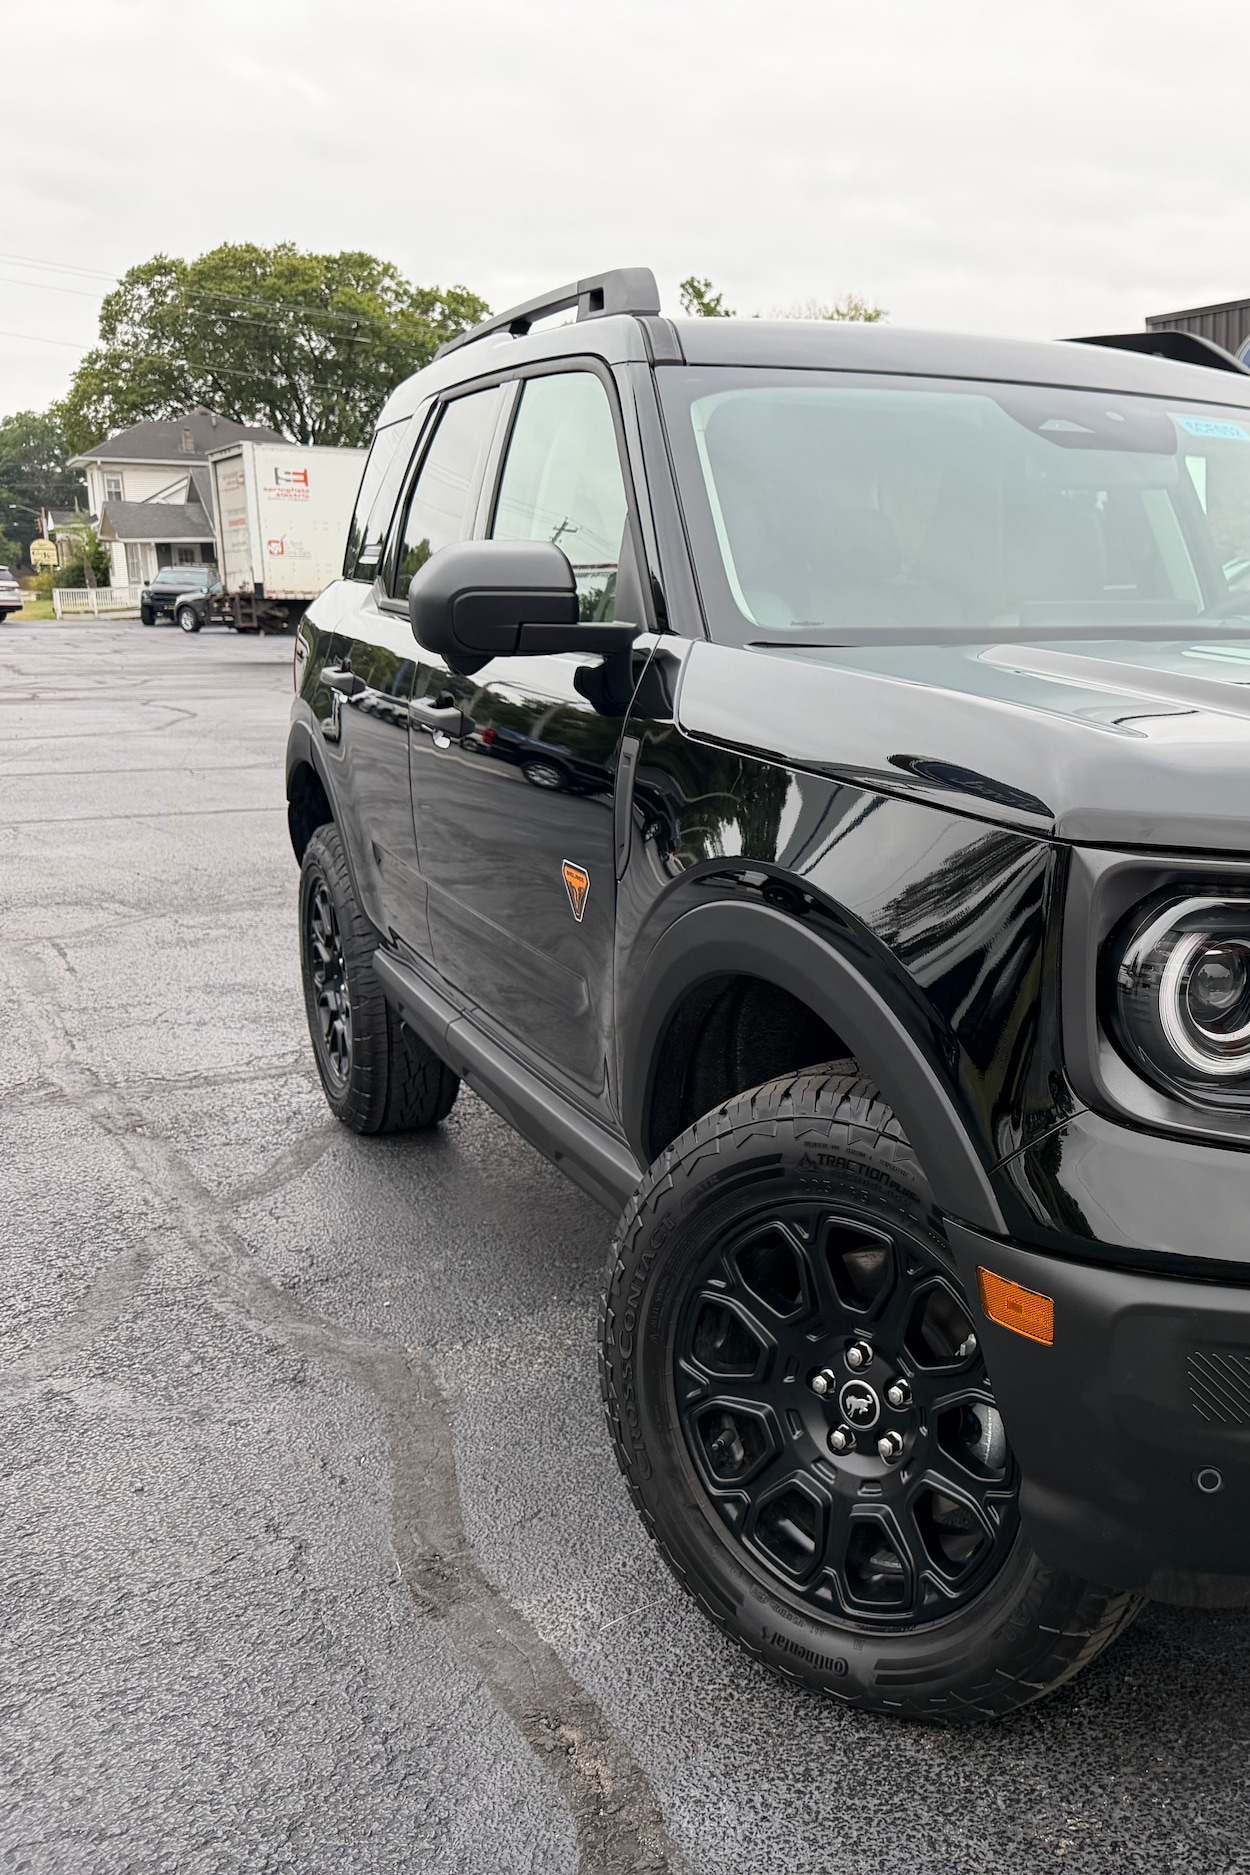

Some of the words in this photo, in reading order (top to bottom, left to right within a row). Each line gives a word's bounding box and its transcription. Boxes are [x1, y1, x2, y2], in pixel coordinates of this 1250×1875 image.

[817, 1153, 891, 1185] TRACTION
[889, 1180, 921, 1203] PLUS
[770, 1631, 850, 1678] Continental
